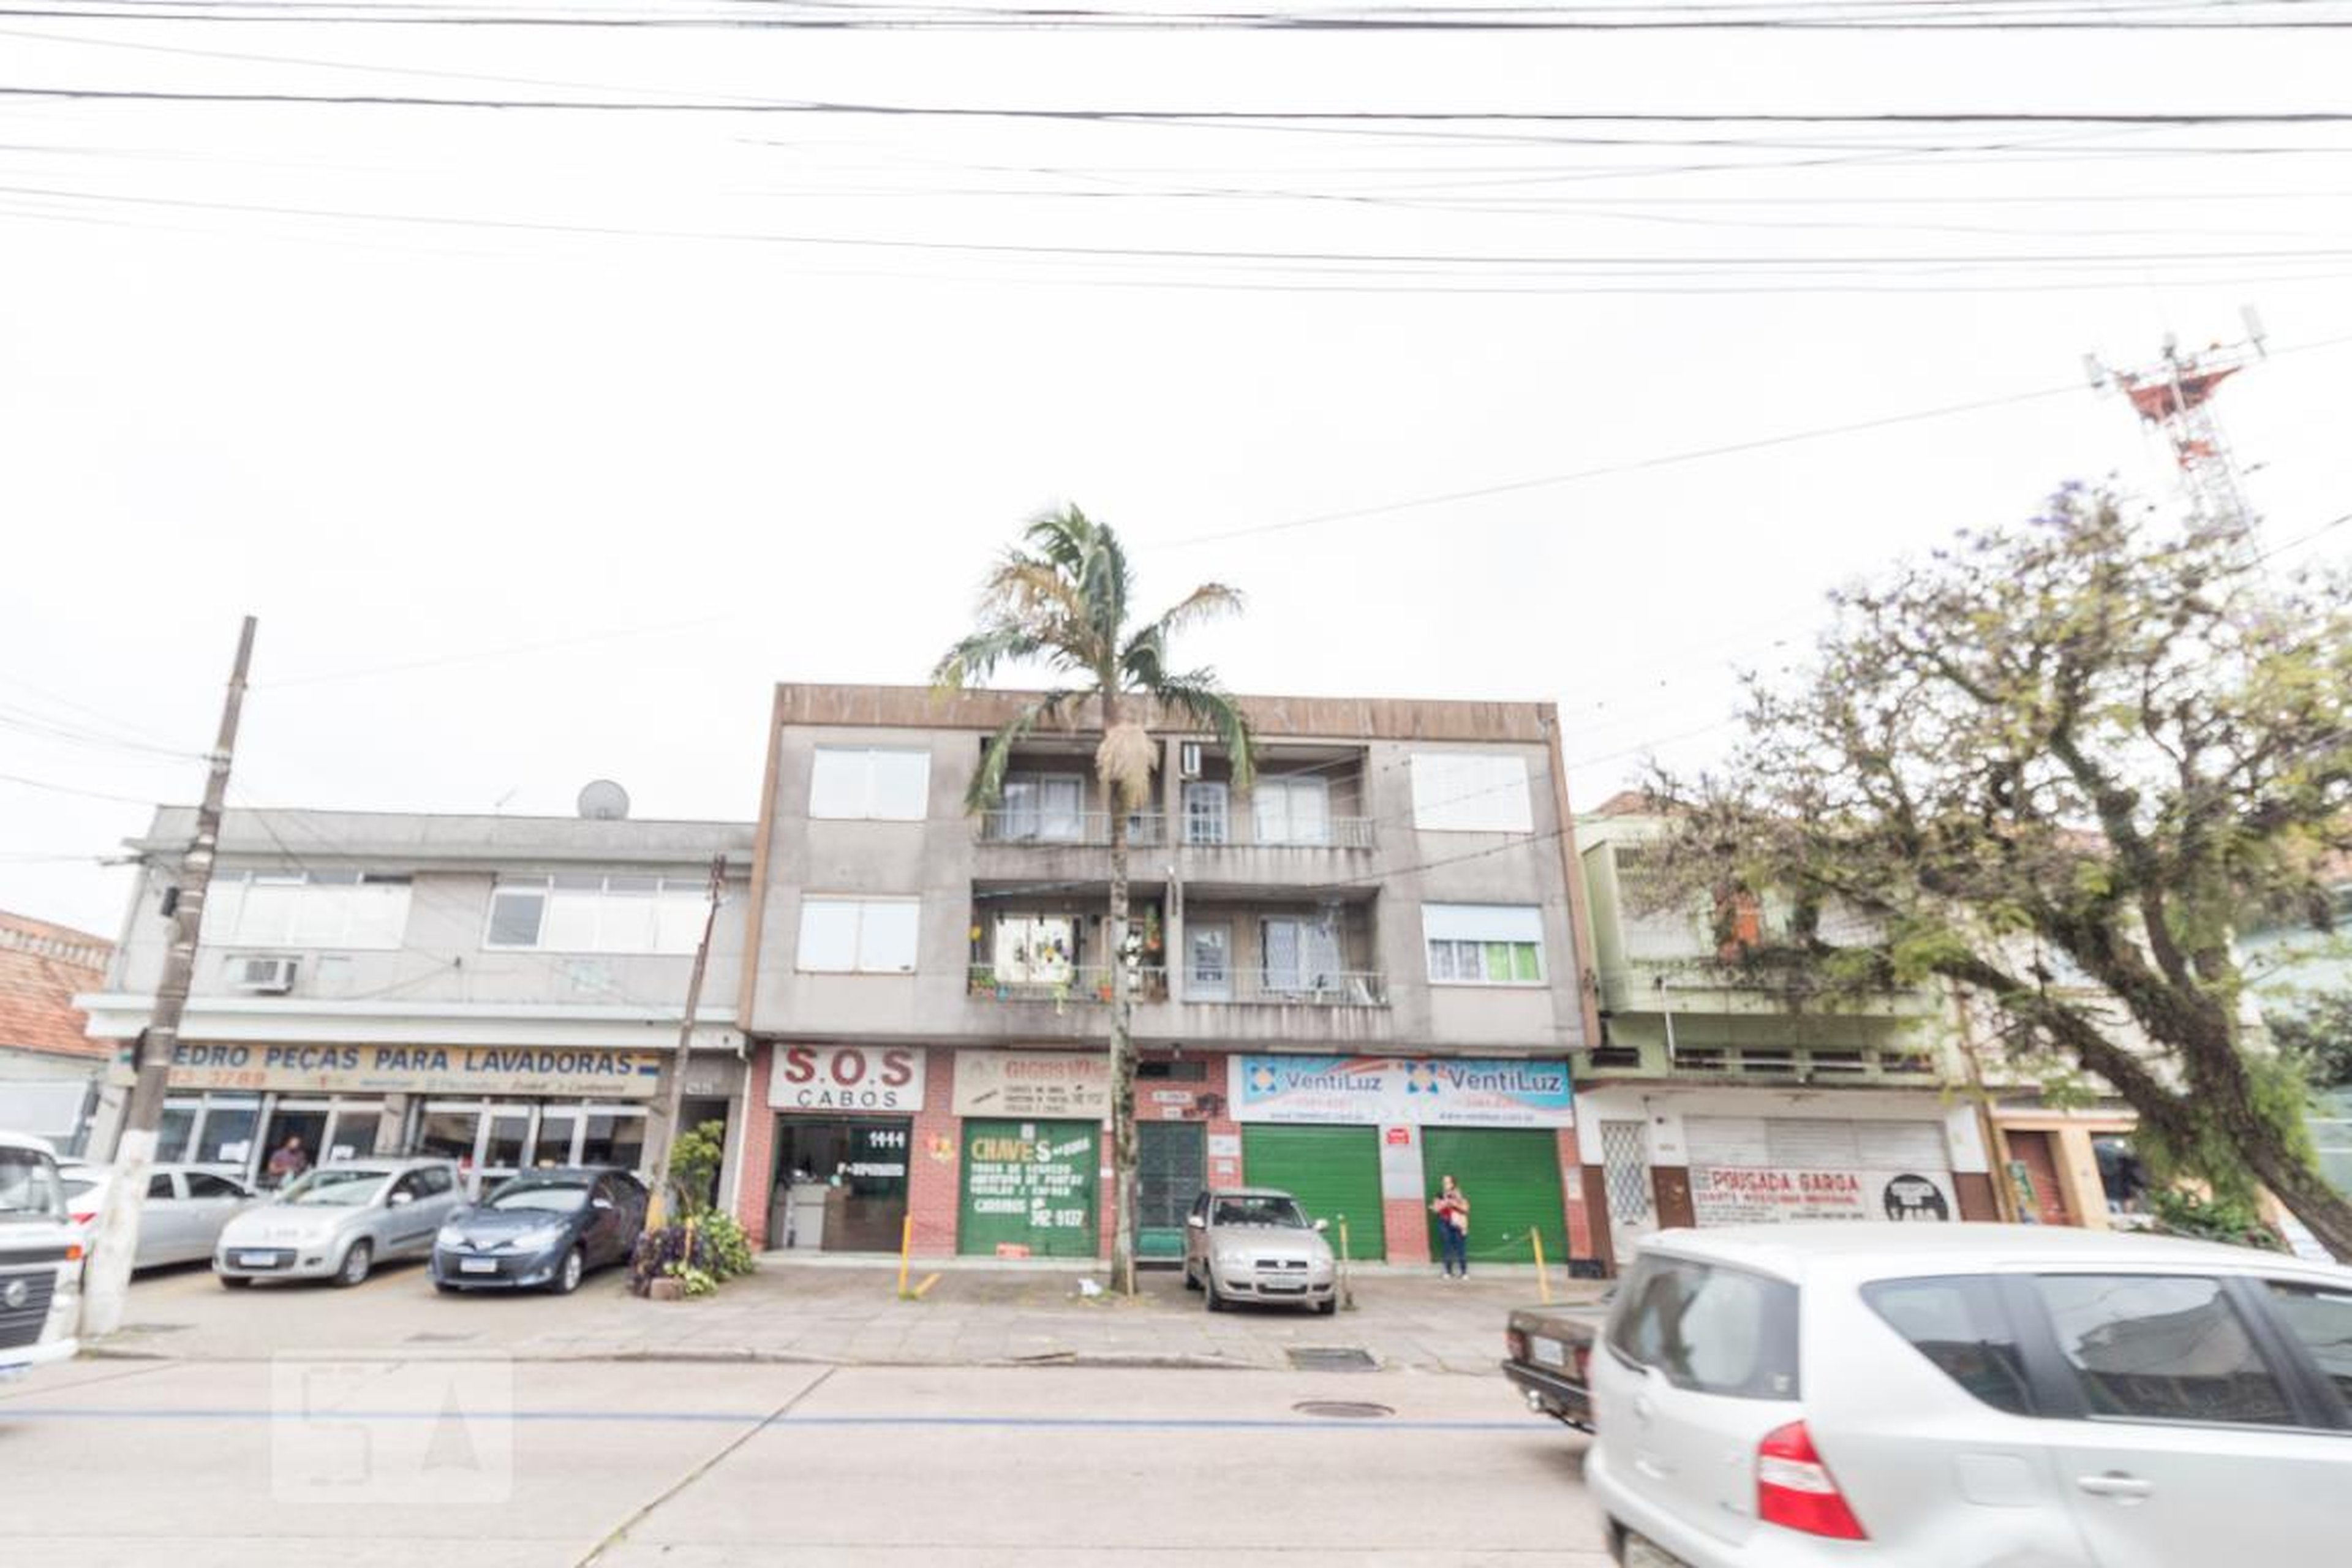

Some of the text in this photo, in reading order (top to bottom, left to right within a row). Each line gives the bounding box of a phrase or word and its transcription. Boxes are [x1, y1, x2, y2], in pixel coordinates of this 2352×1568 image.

[172, 1044, 633, 1075] EDRO PEÇAS PARA LAVADORAS
[785, 1047, 914, 1087] S.O.S
[1287, 1072, 1382, 1091] VentiLuz
[1447, 1069, 1561, 1092] VentiLuz
[797, 1089, 898, 1107] CABOS
